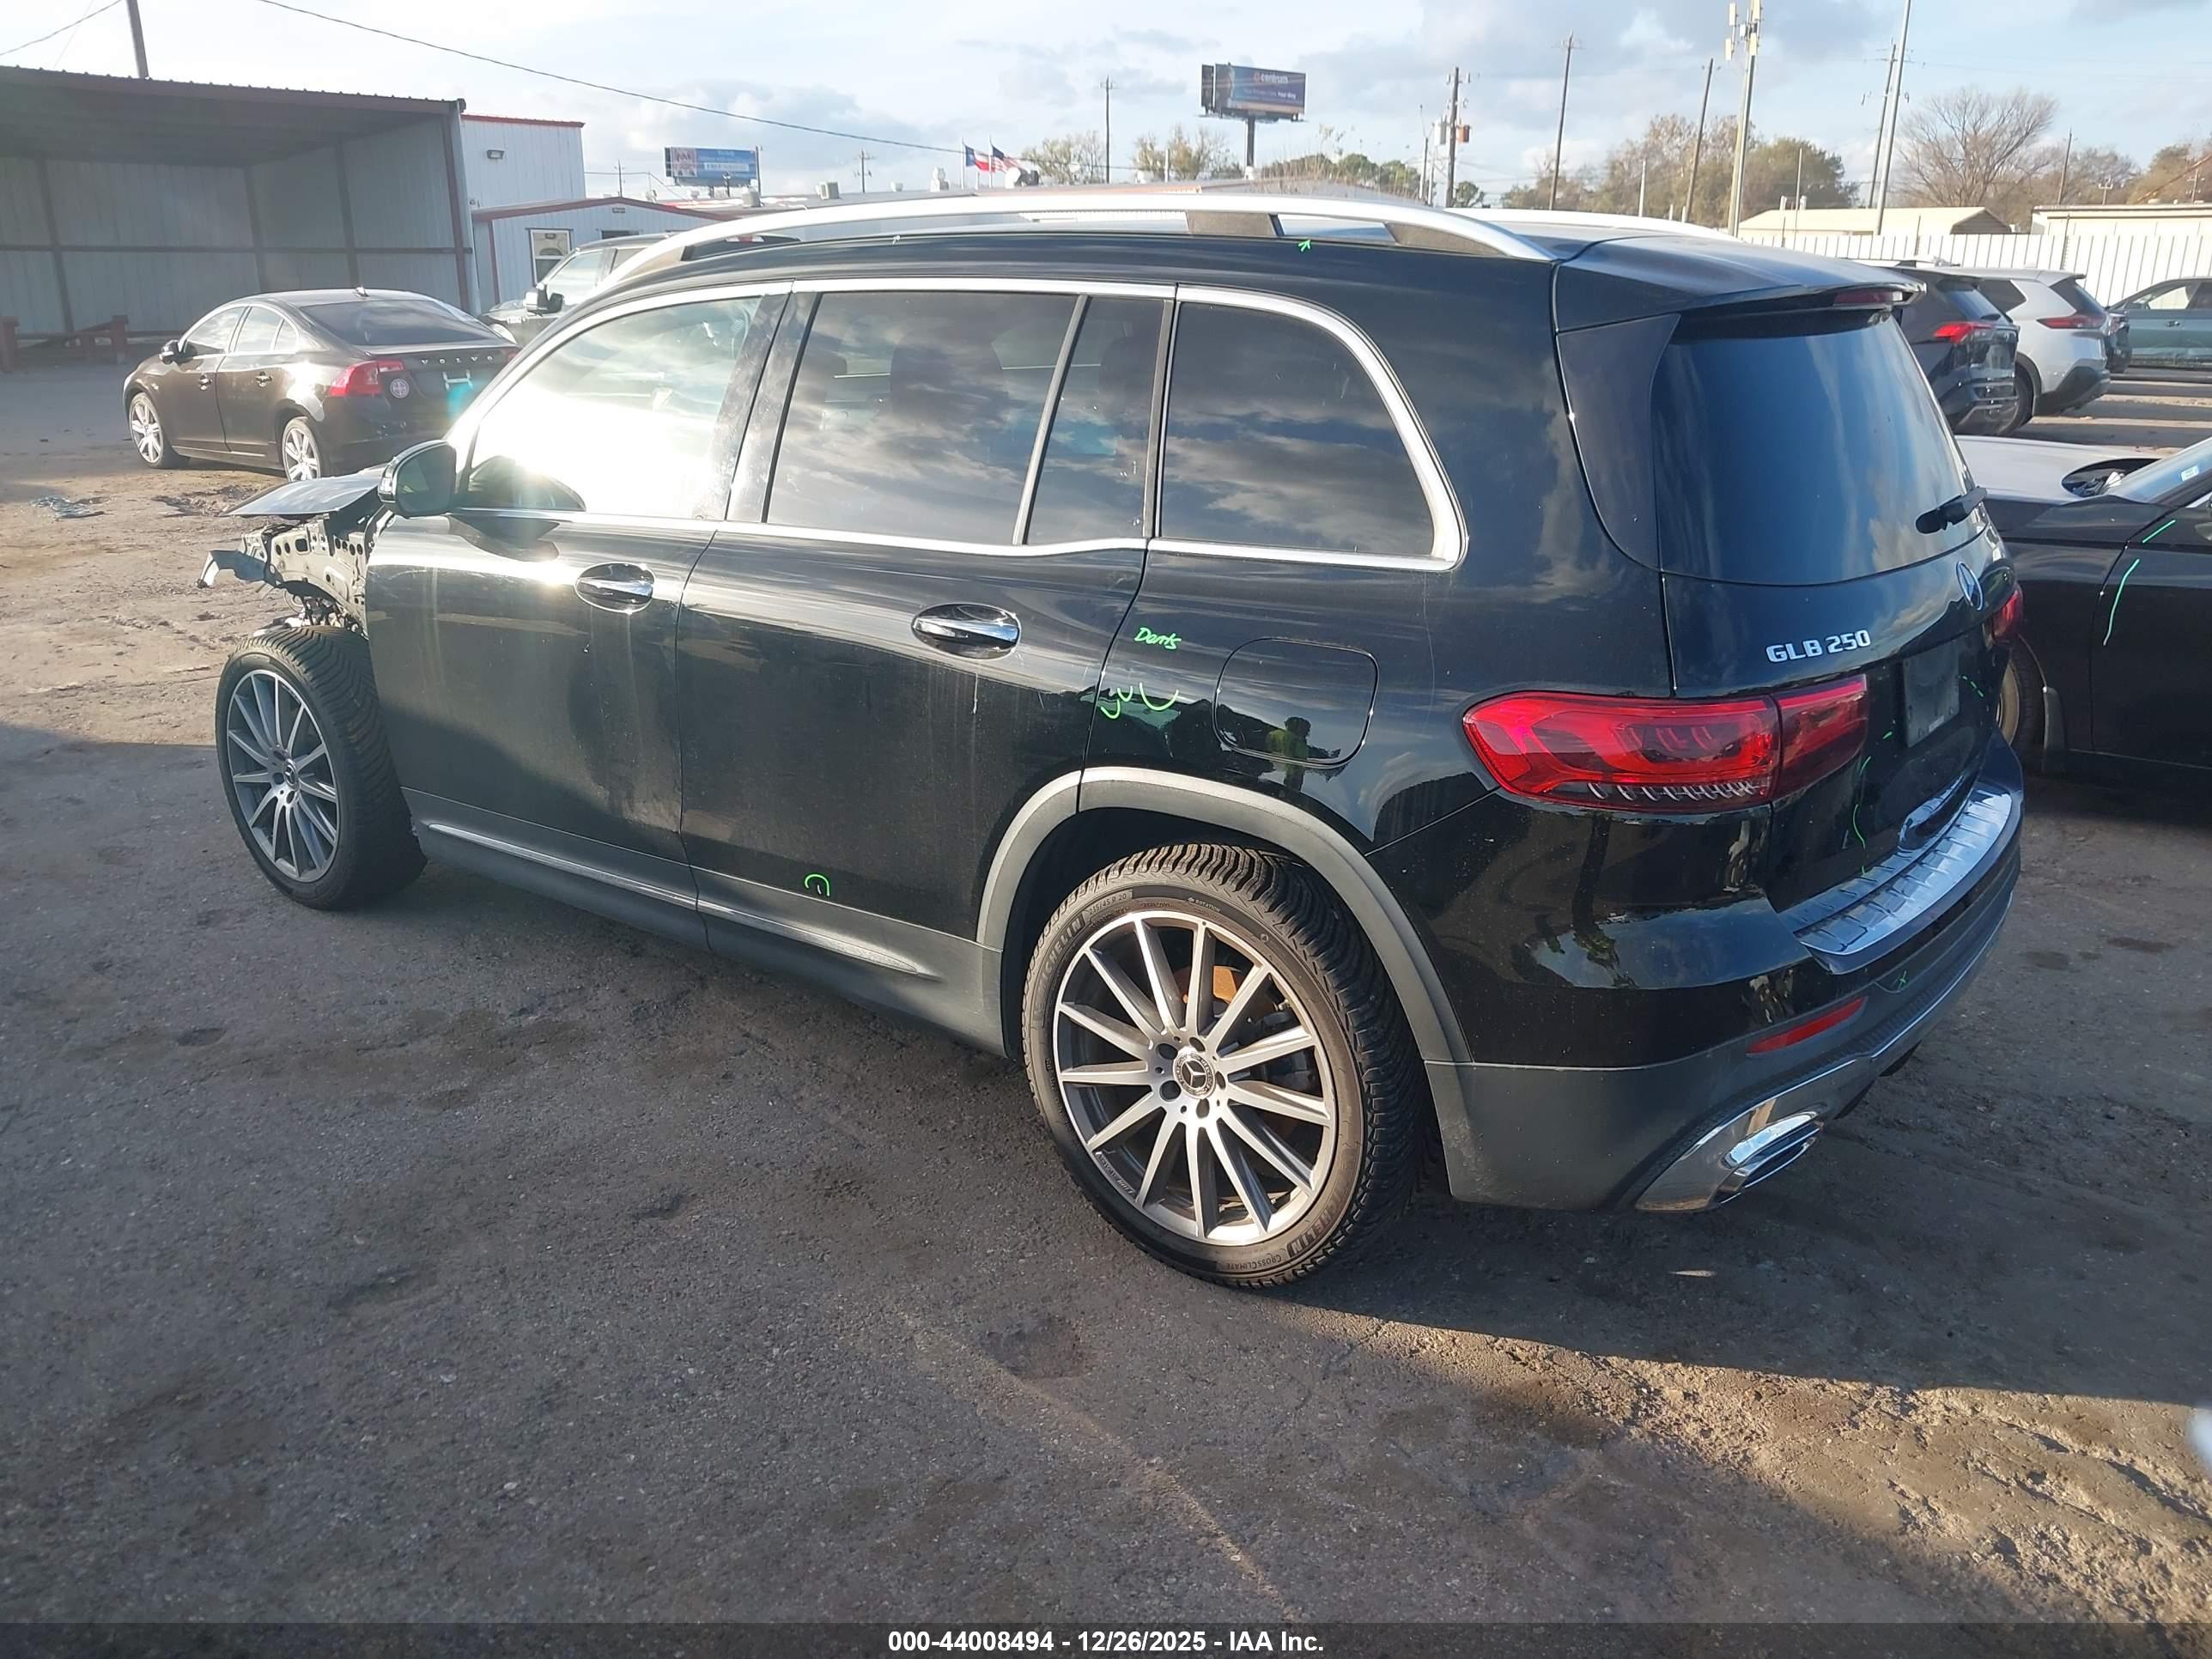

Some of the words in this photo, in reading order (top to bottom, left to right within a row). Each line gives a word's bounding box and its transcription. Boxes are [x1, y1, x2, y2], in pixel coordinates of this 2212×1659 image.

[421, 356, 493, 365] VOLVO
[1134, 627, 1182, 649] Dents
[1765, 640, 1823, 662] GLB
[1825, 629, 1871, 653] 250
